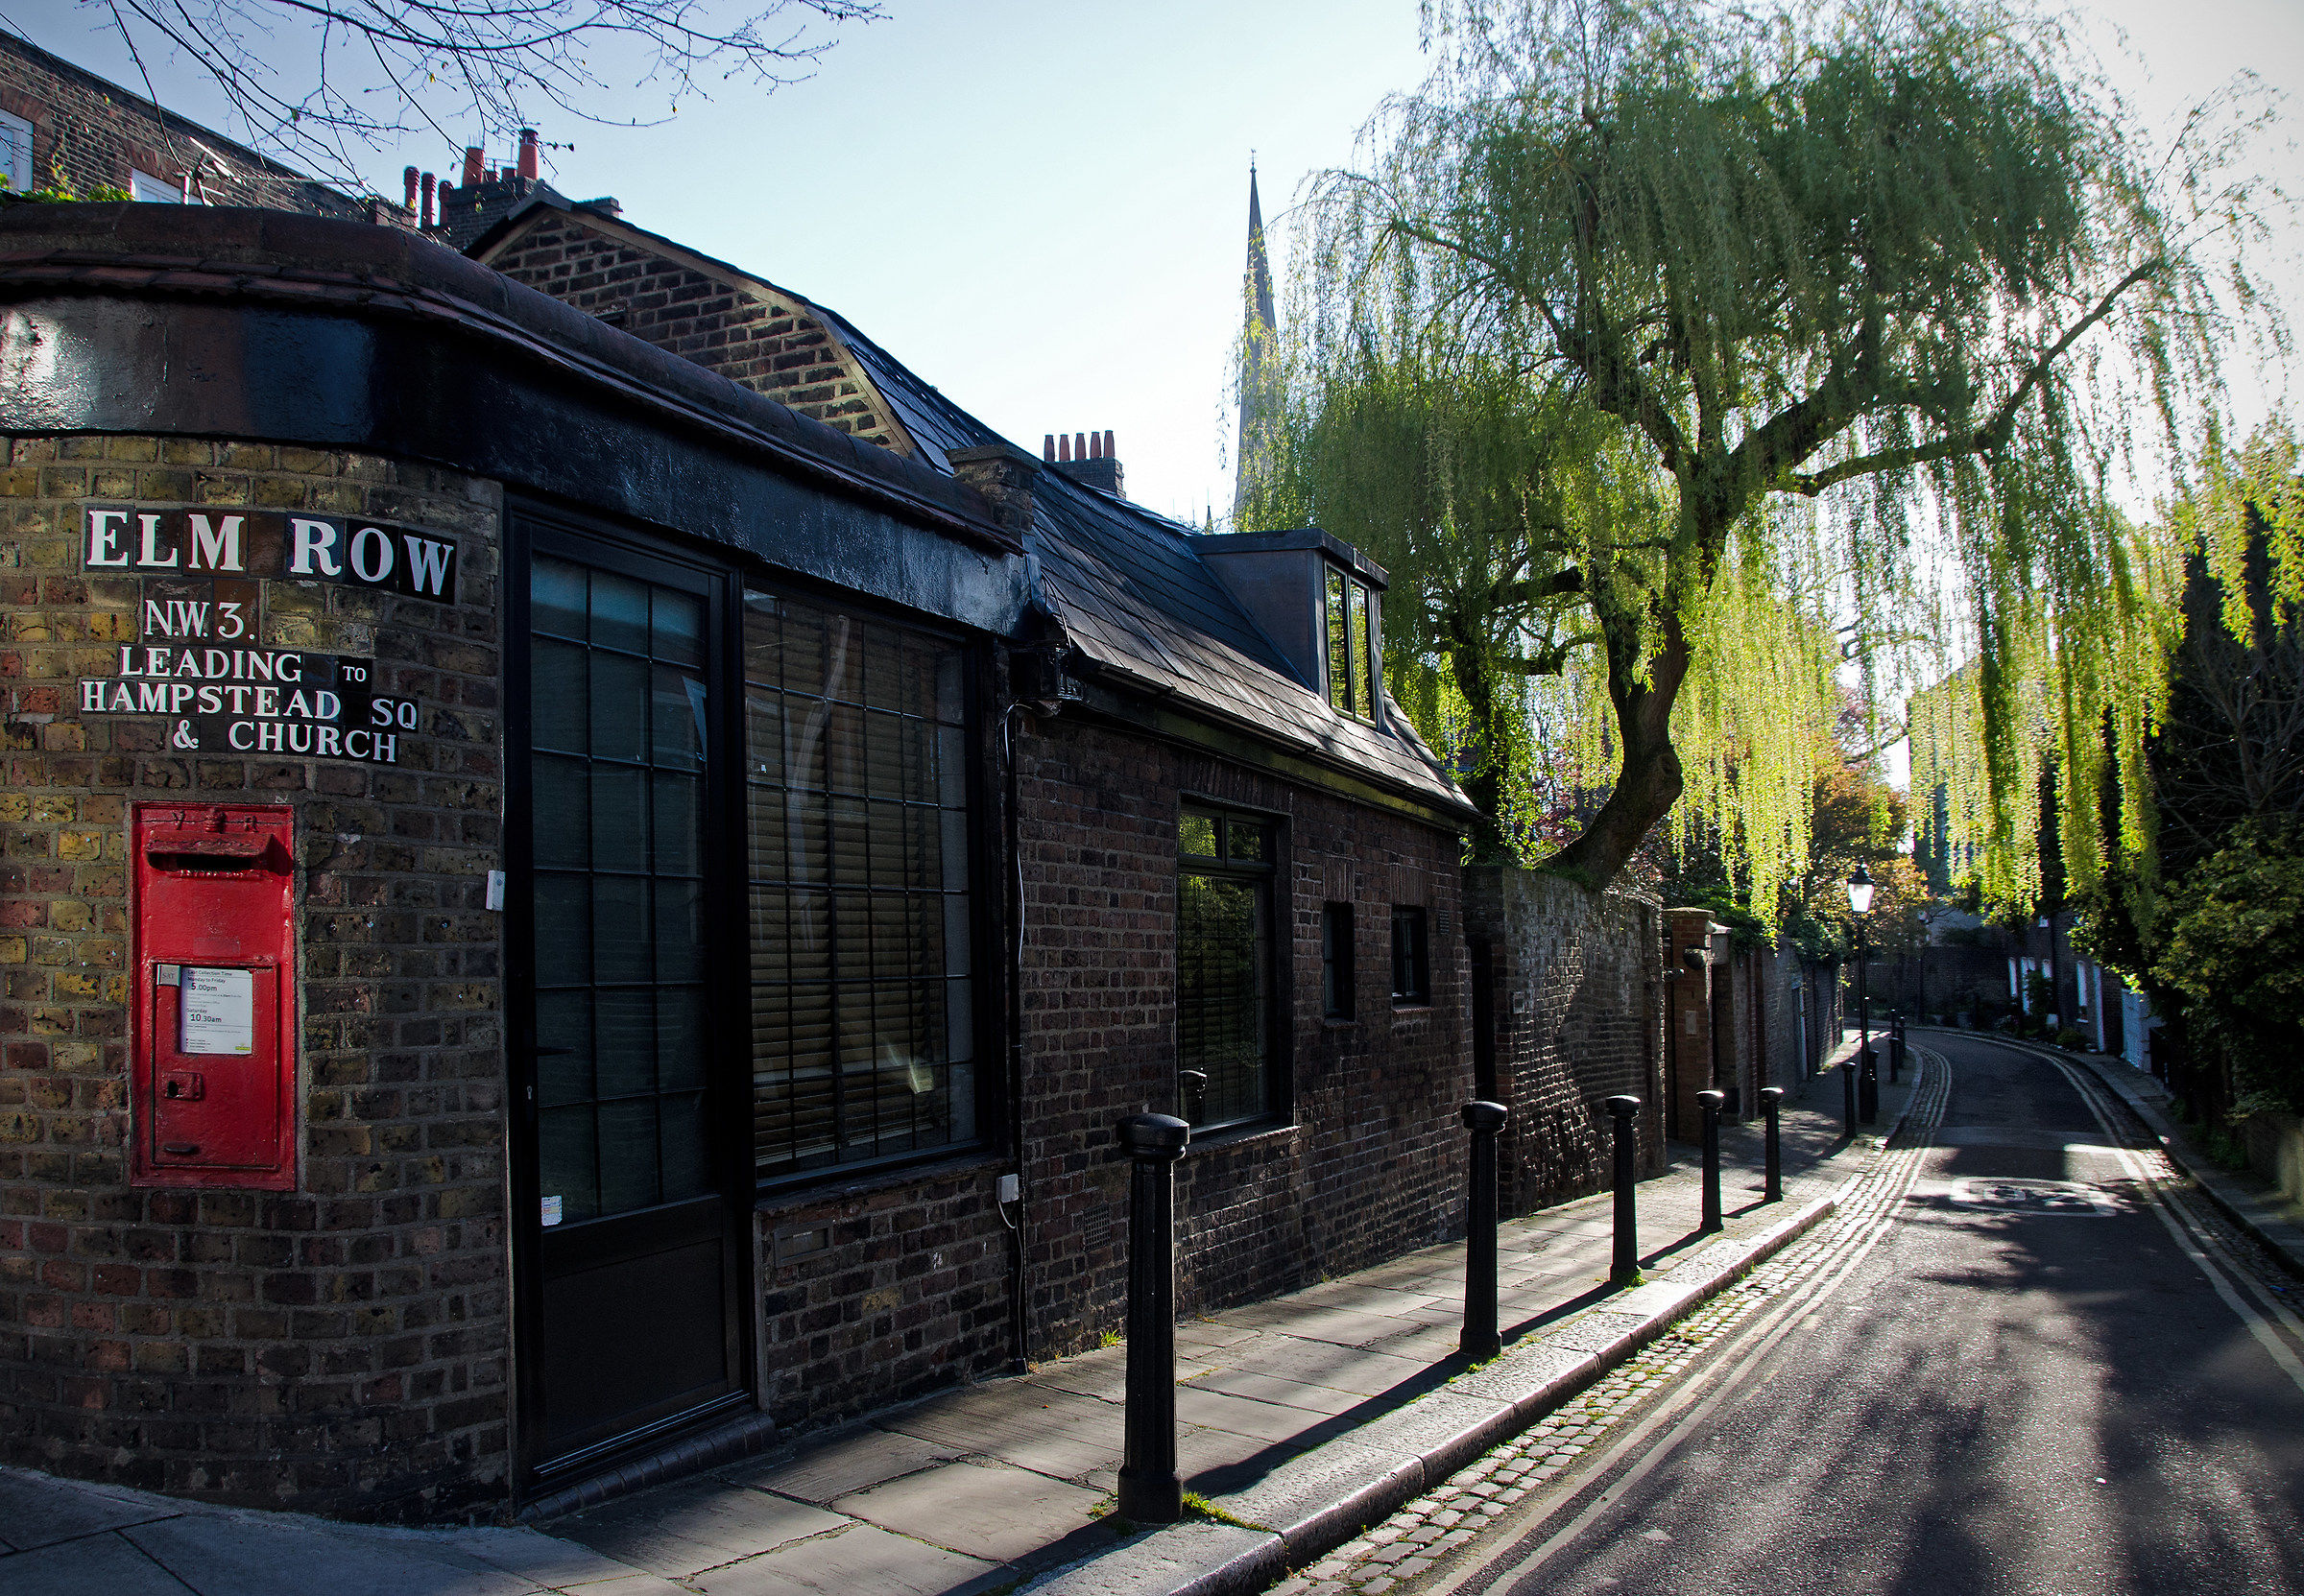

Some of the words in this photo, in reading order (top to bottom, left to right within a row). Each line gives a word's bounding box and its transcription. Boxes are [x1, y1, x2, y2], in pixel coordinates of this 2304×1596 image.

[87, 511, 245, 572] ELM
[290, 517, 455, 596] ROW
[120, 646, 303, 682] LEADING
[343, 666, 367, 682] TO
[82, 680, 342, 720] HAMPSTEAD
[372, 699, 418, 730] SQ
[173, 720, 200, 750] &
[228, 721, 397, 762] CHURCH
[191, 982, 218, 991] 5.00pm
[190, 1013, 223, 1022] 10.30am
